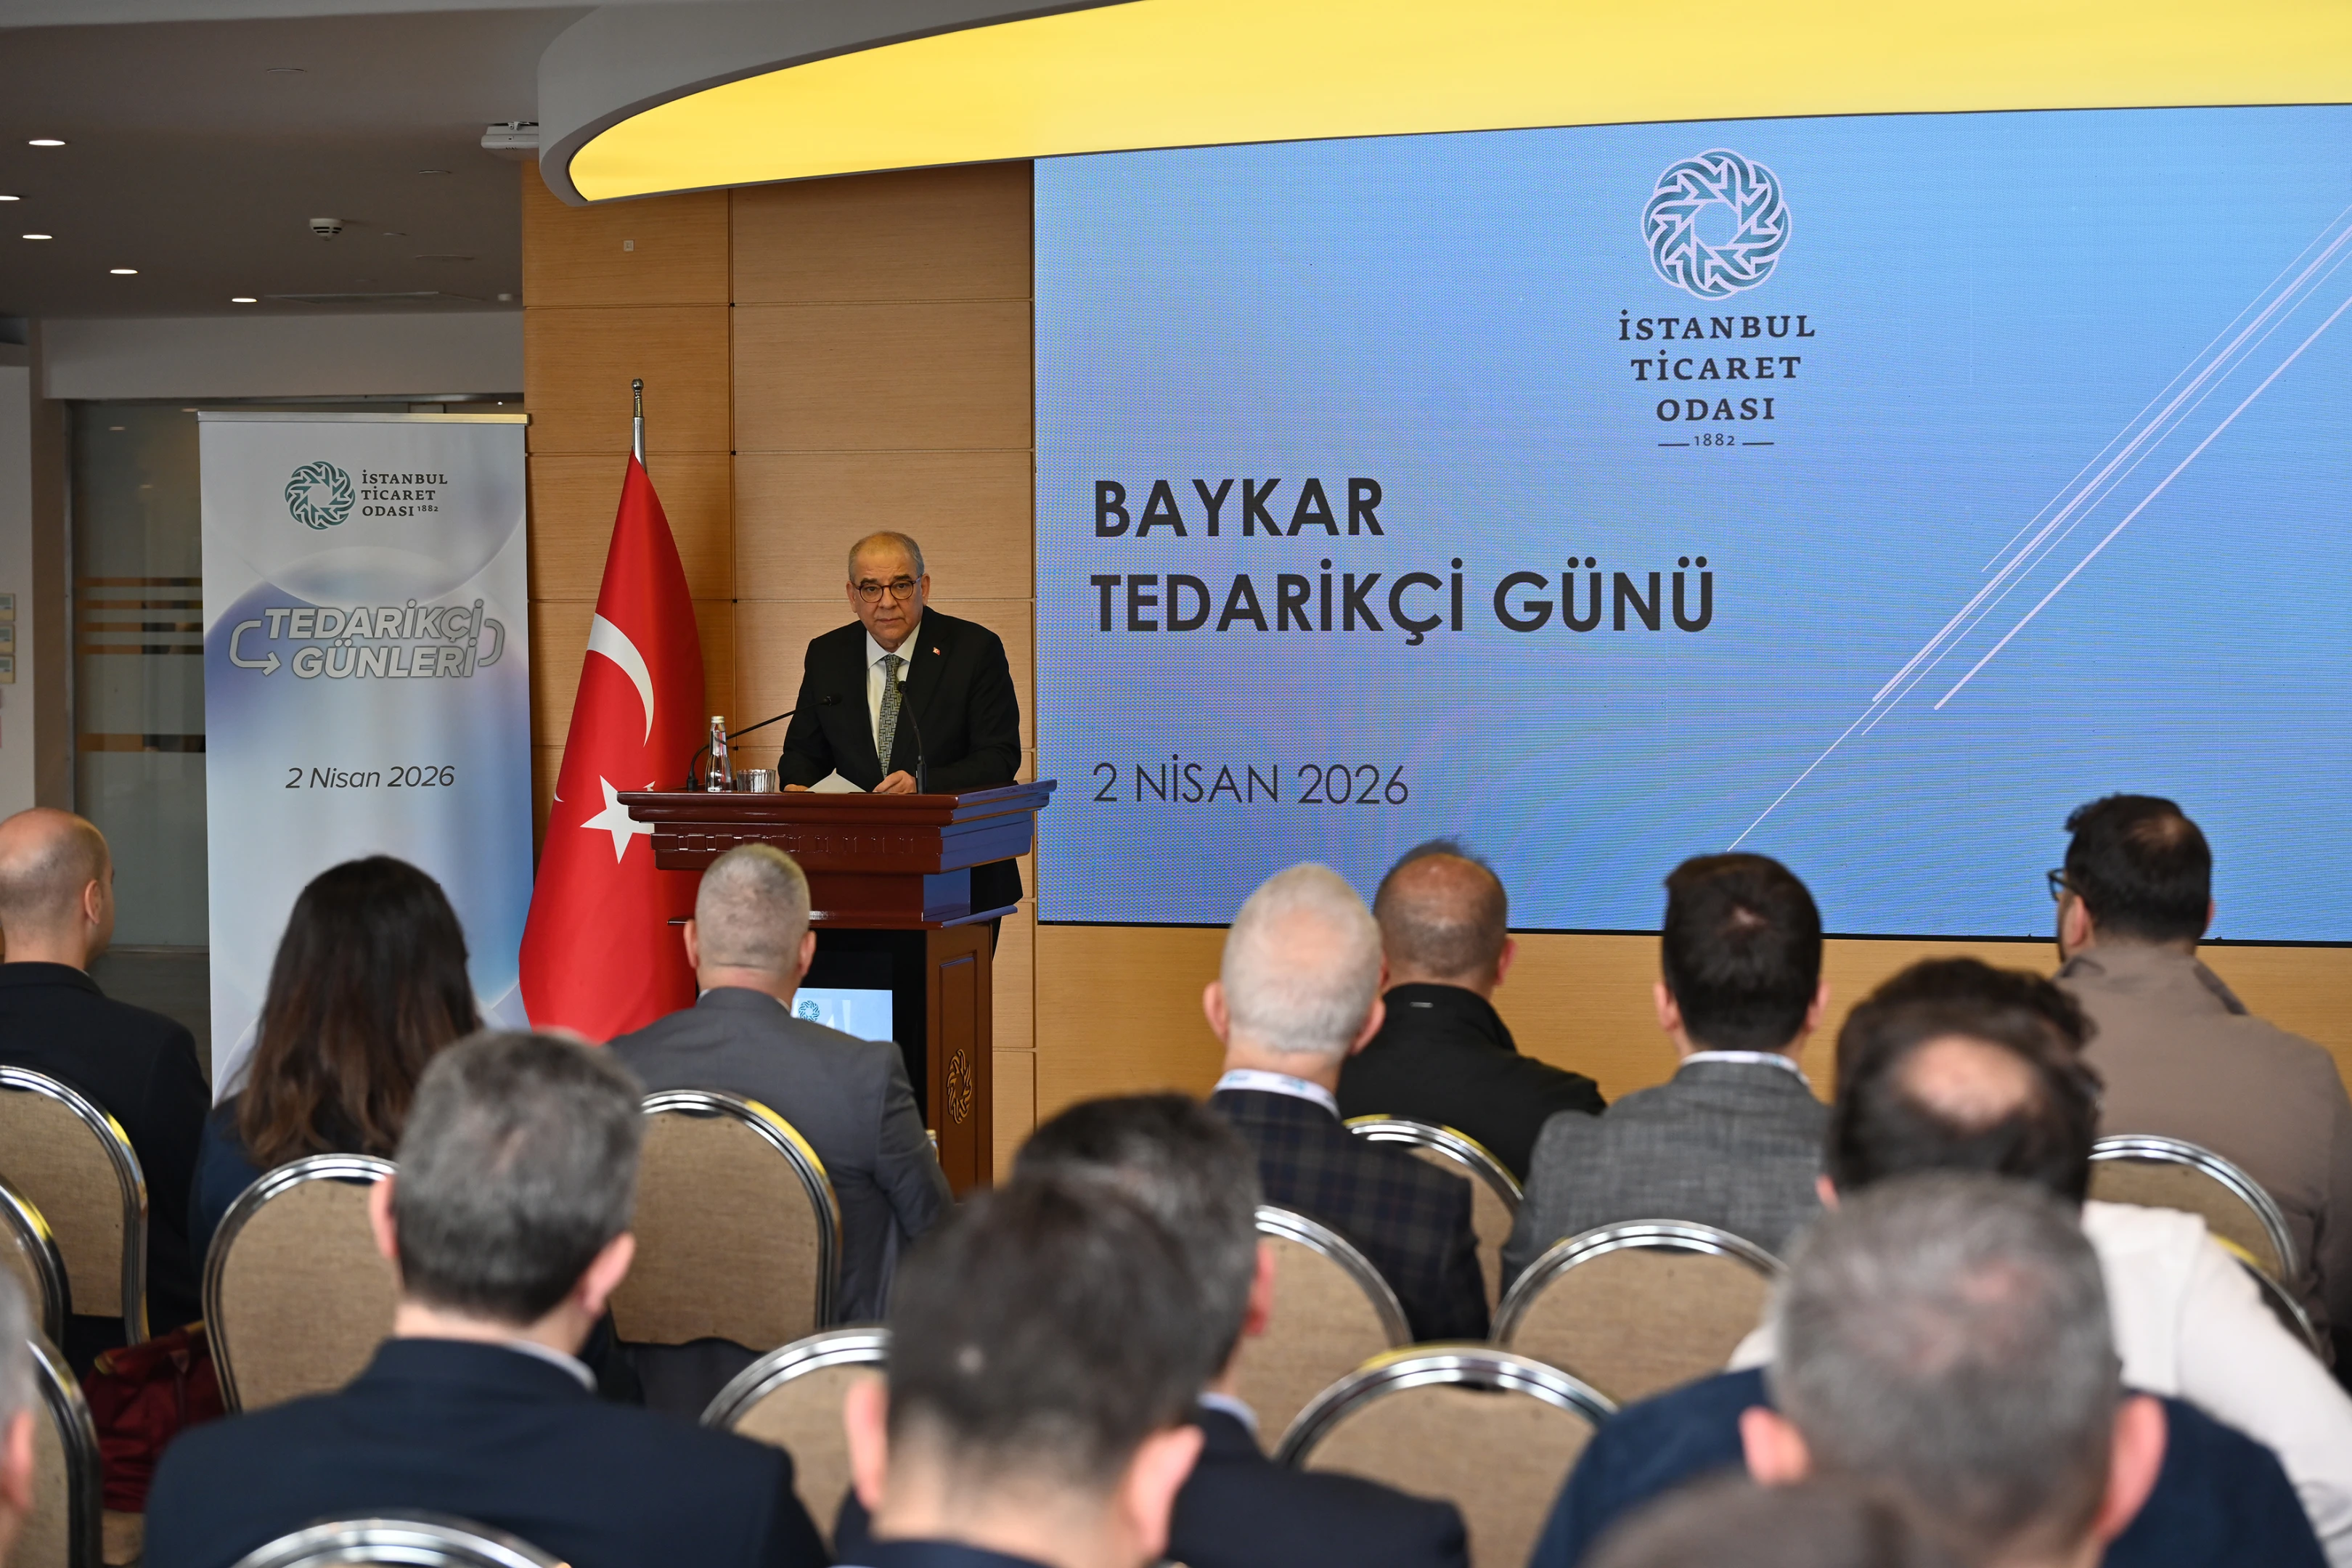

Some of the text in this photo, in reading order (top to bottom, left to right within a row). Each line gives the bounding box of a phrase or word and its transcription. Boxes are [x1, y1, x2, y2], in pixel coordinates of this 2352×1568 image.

[1619, 309, 1816, 341] İSTANBUL
[1630, 348, 1802, 382] TİCARET
[1656, 398, 1775, 422] ODASI
[1694, 433, 1736, 446] 1882
[362, 469, 448, 484] İSTANBUL
[362, 486, 436, 500] TİCARET
[1095, 477, 1384, 538] BAYKAR
[362, 506, 415, 517] ODASI
[1090, 556, 1714, 647] TEDARİKÇİ GÜNÜ
[264, 599, 484, 642] TEDARİKÇİ
[293, 638, 478, 679] GÜNLERİ
[285, 765, 455, 788] 2 Nisan 2026
[1092, 752, 1410, 807] 2 NİSAN 2026
